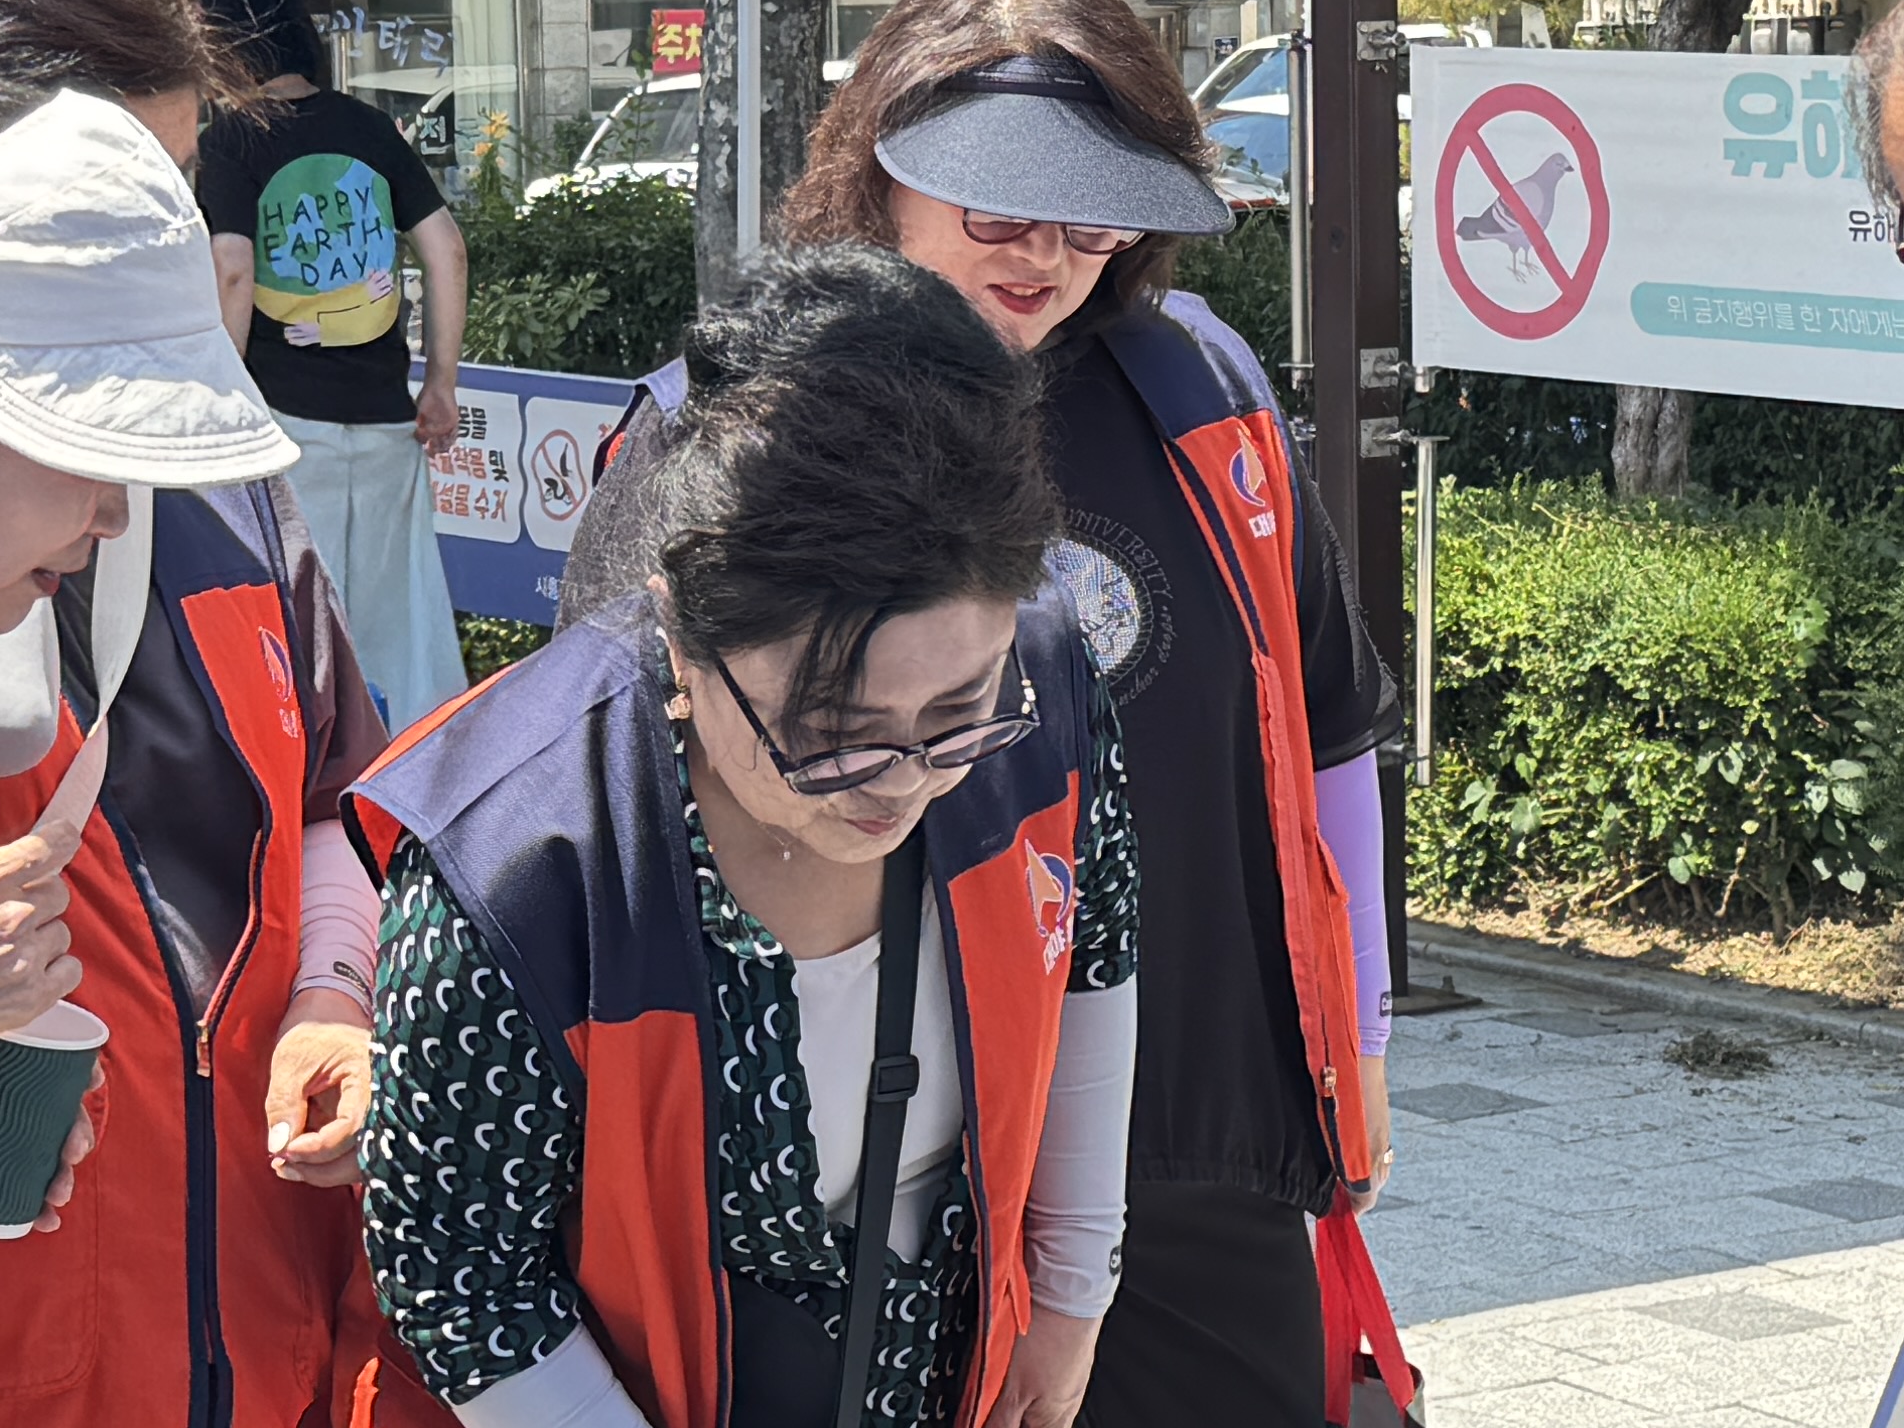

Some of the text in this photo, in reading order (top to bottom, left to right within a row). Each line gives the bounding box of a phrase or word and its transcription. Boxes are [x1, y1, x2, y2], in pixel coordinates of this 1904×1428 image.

[263, 186, 369, 230] HAPPY
[263, 217, 383, 262] EARTH
[300, 251, 368, 287] DAY
[1667, 296, 1688, 321] 위
[1693, 298, 1795, 331] 금지행위를
[1800, 304, 1822, 333] 한
